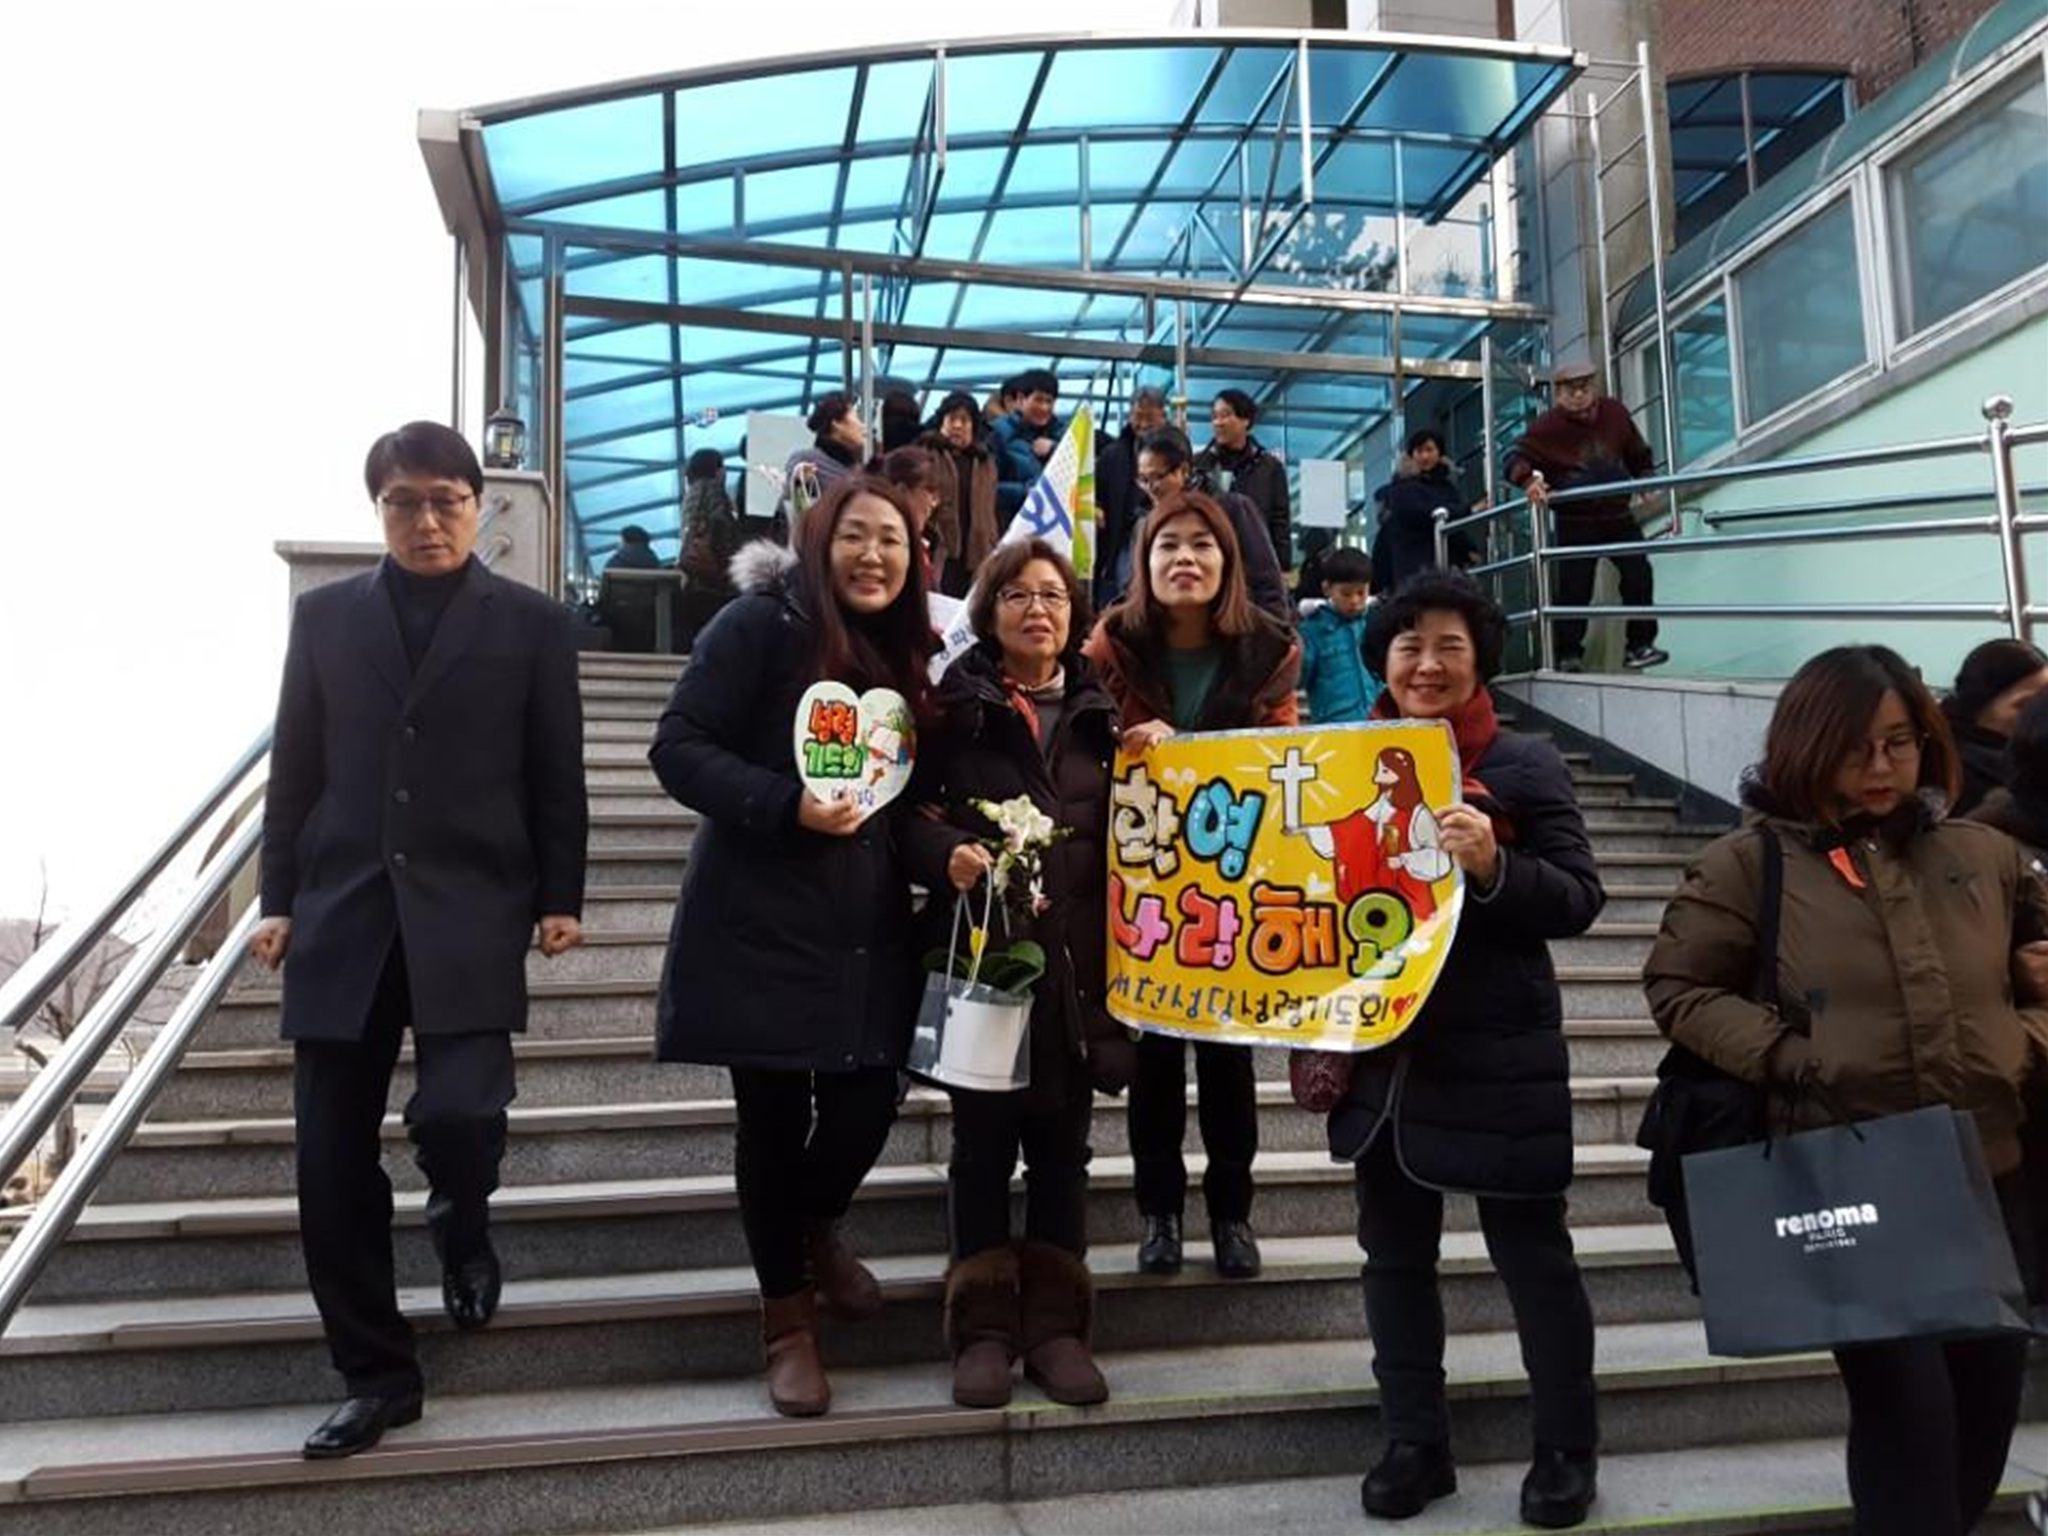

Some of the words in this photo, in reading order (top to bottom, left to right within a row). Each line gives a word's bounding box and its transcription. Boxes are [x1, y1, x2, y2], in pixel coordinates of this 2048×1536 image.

[803, 738, 864, 779] 기도회
[1111, 762, 1266, 882] 환영
[1775, 1203, 1878, 1238] renoma
